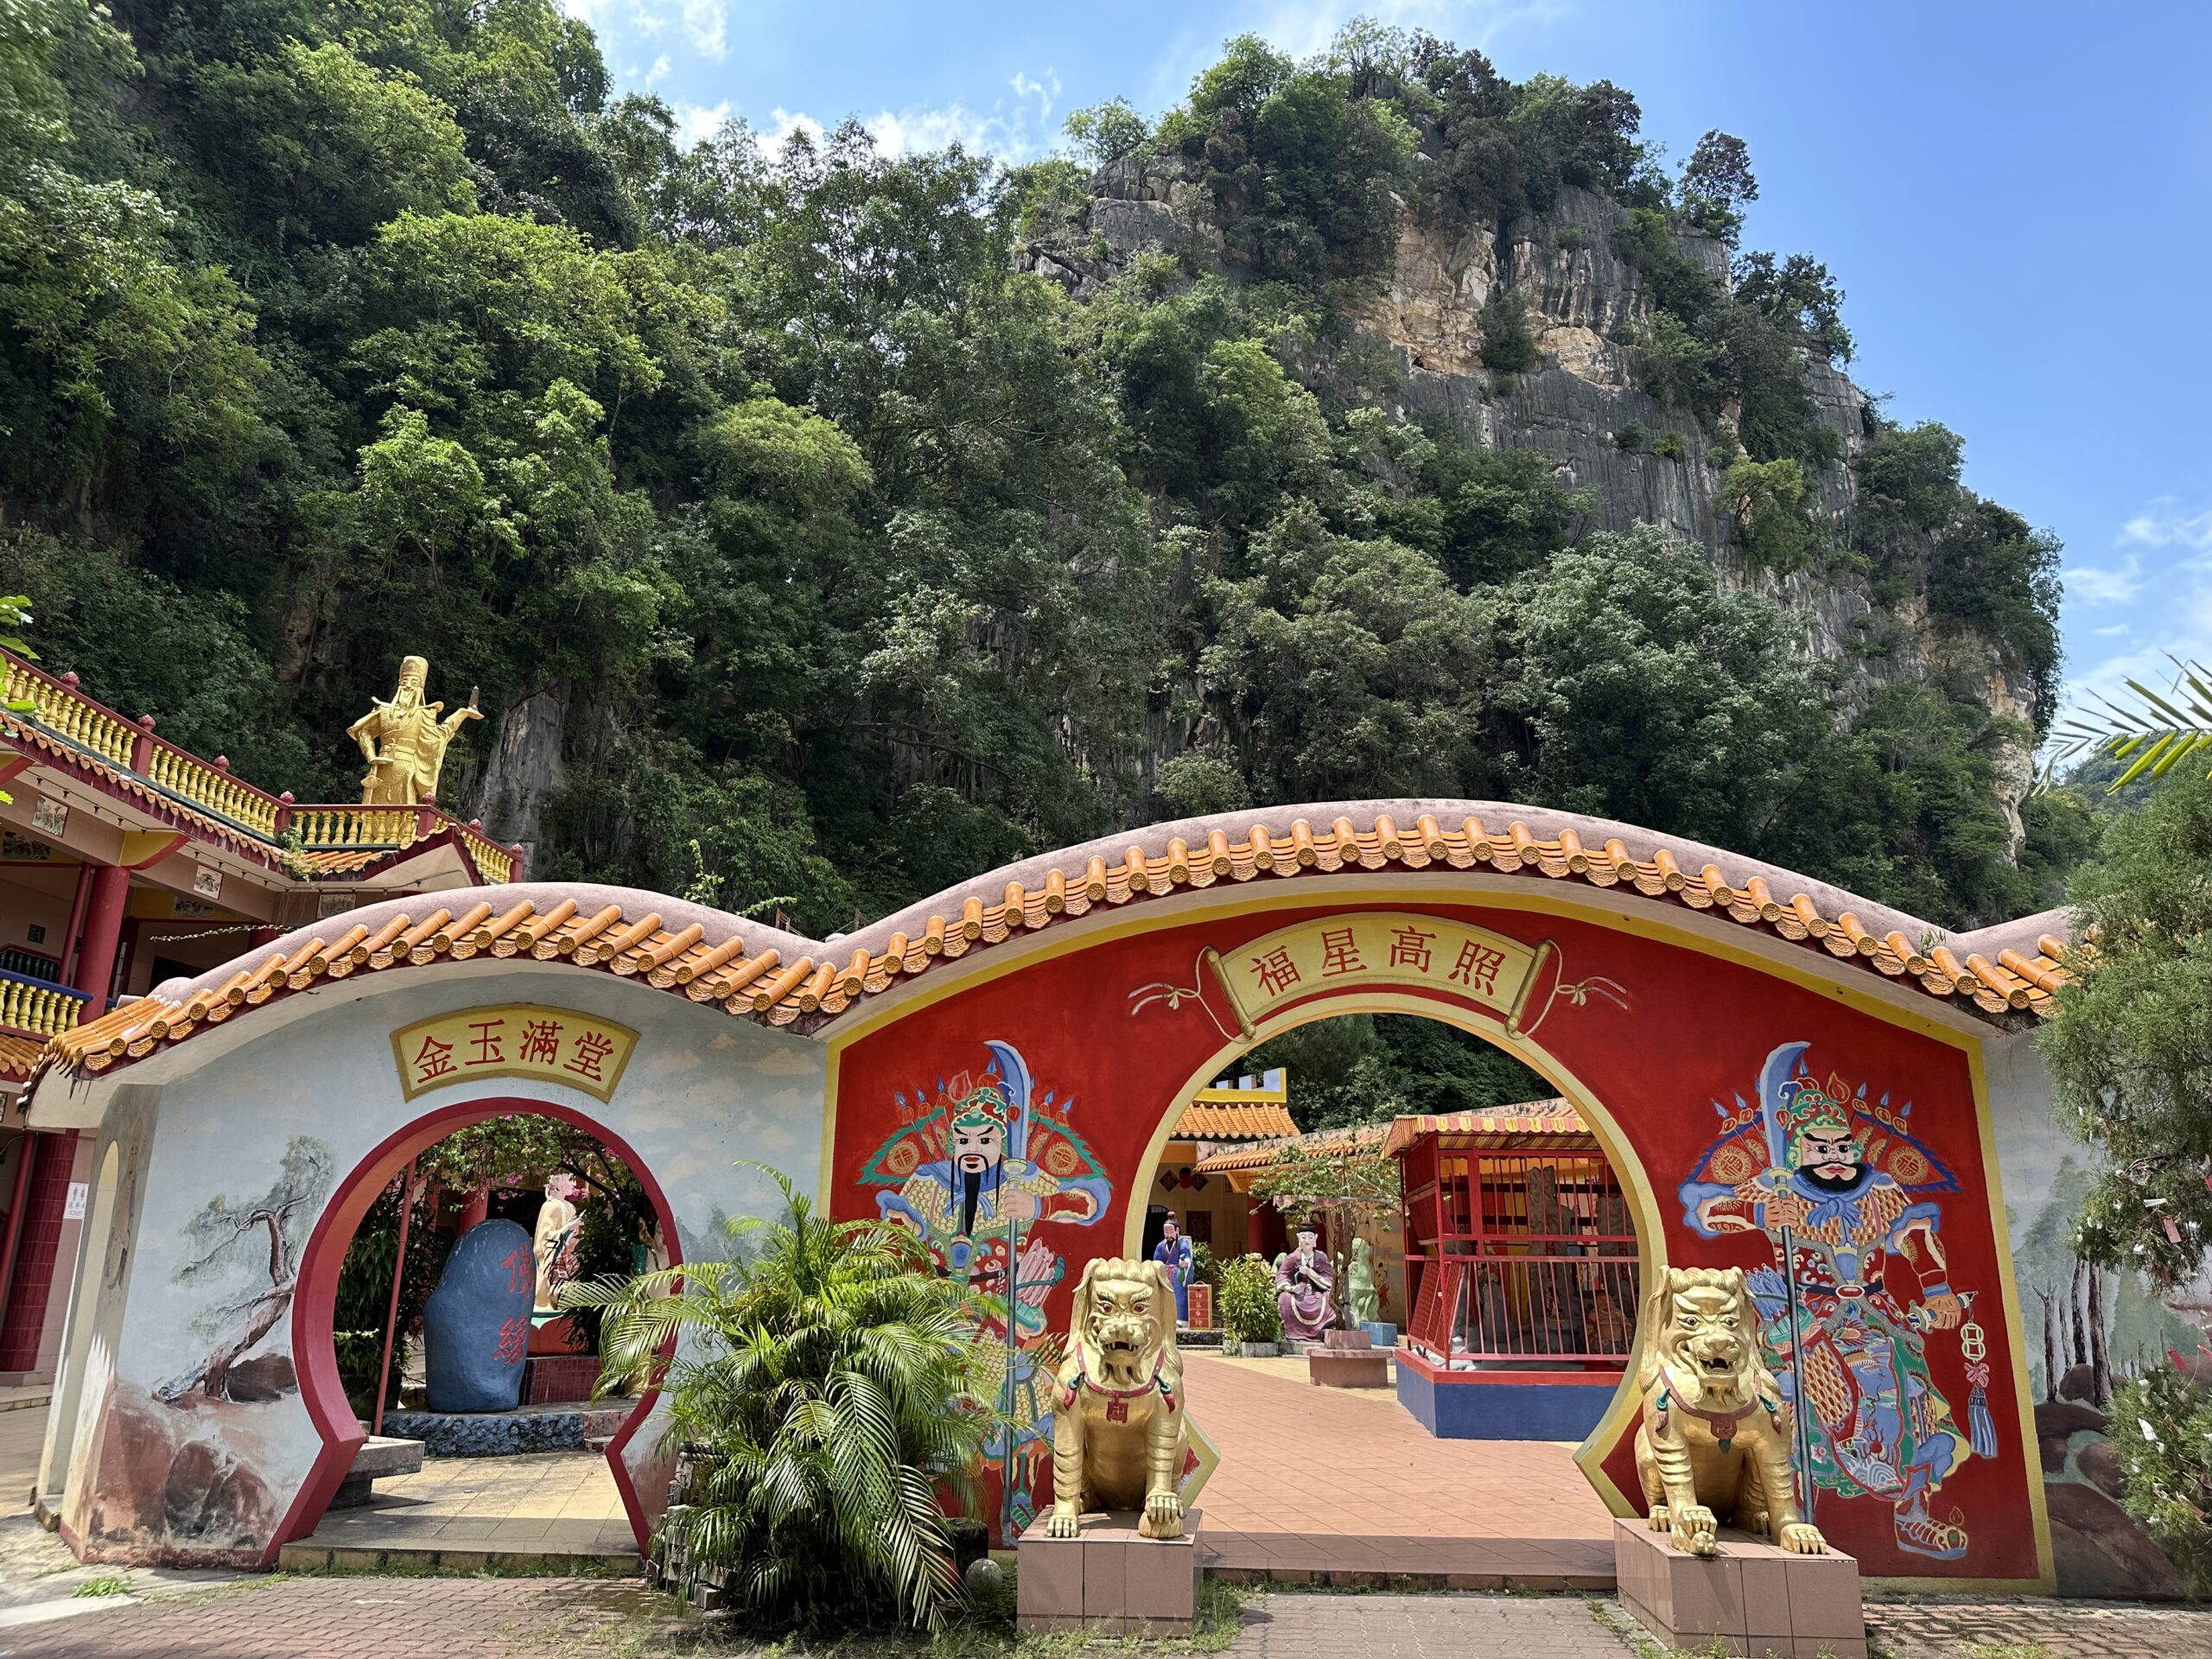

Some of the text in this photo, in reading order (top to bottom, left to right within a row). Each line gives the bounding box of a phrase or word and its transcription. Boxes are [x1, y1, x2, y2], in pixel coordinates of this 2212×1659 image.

[1249, 925, 1506, 997] 福星高照
[413, 1018, 614, 1084] 金玉滿堂
